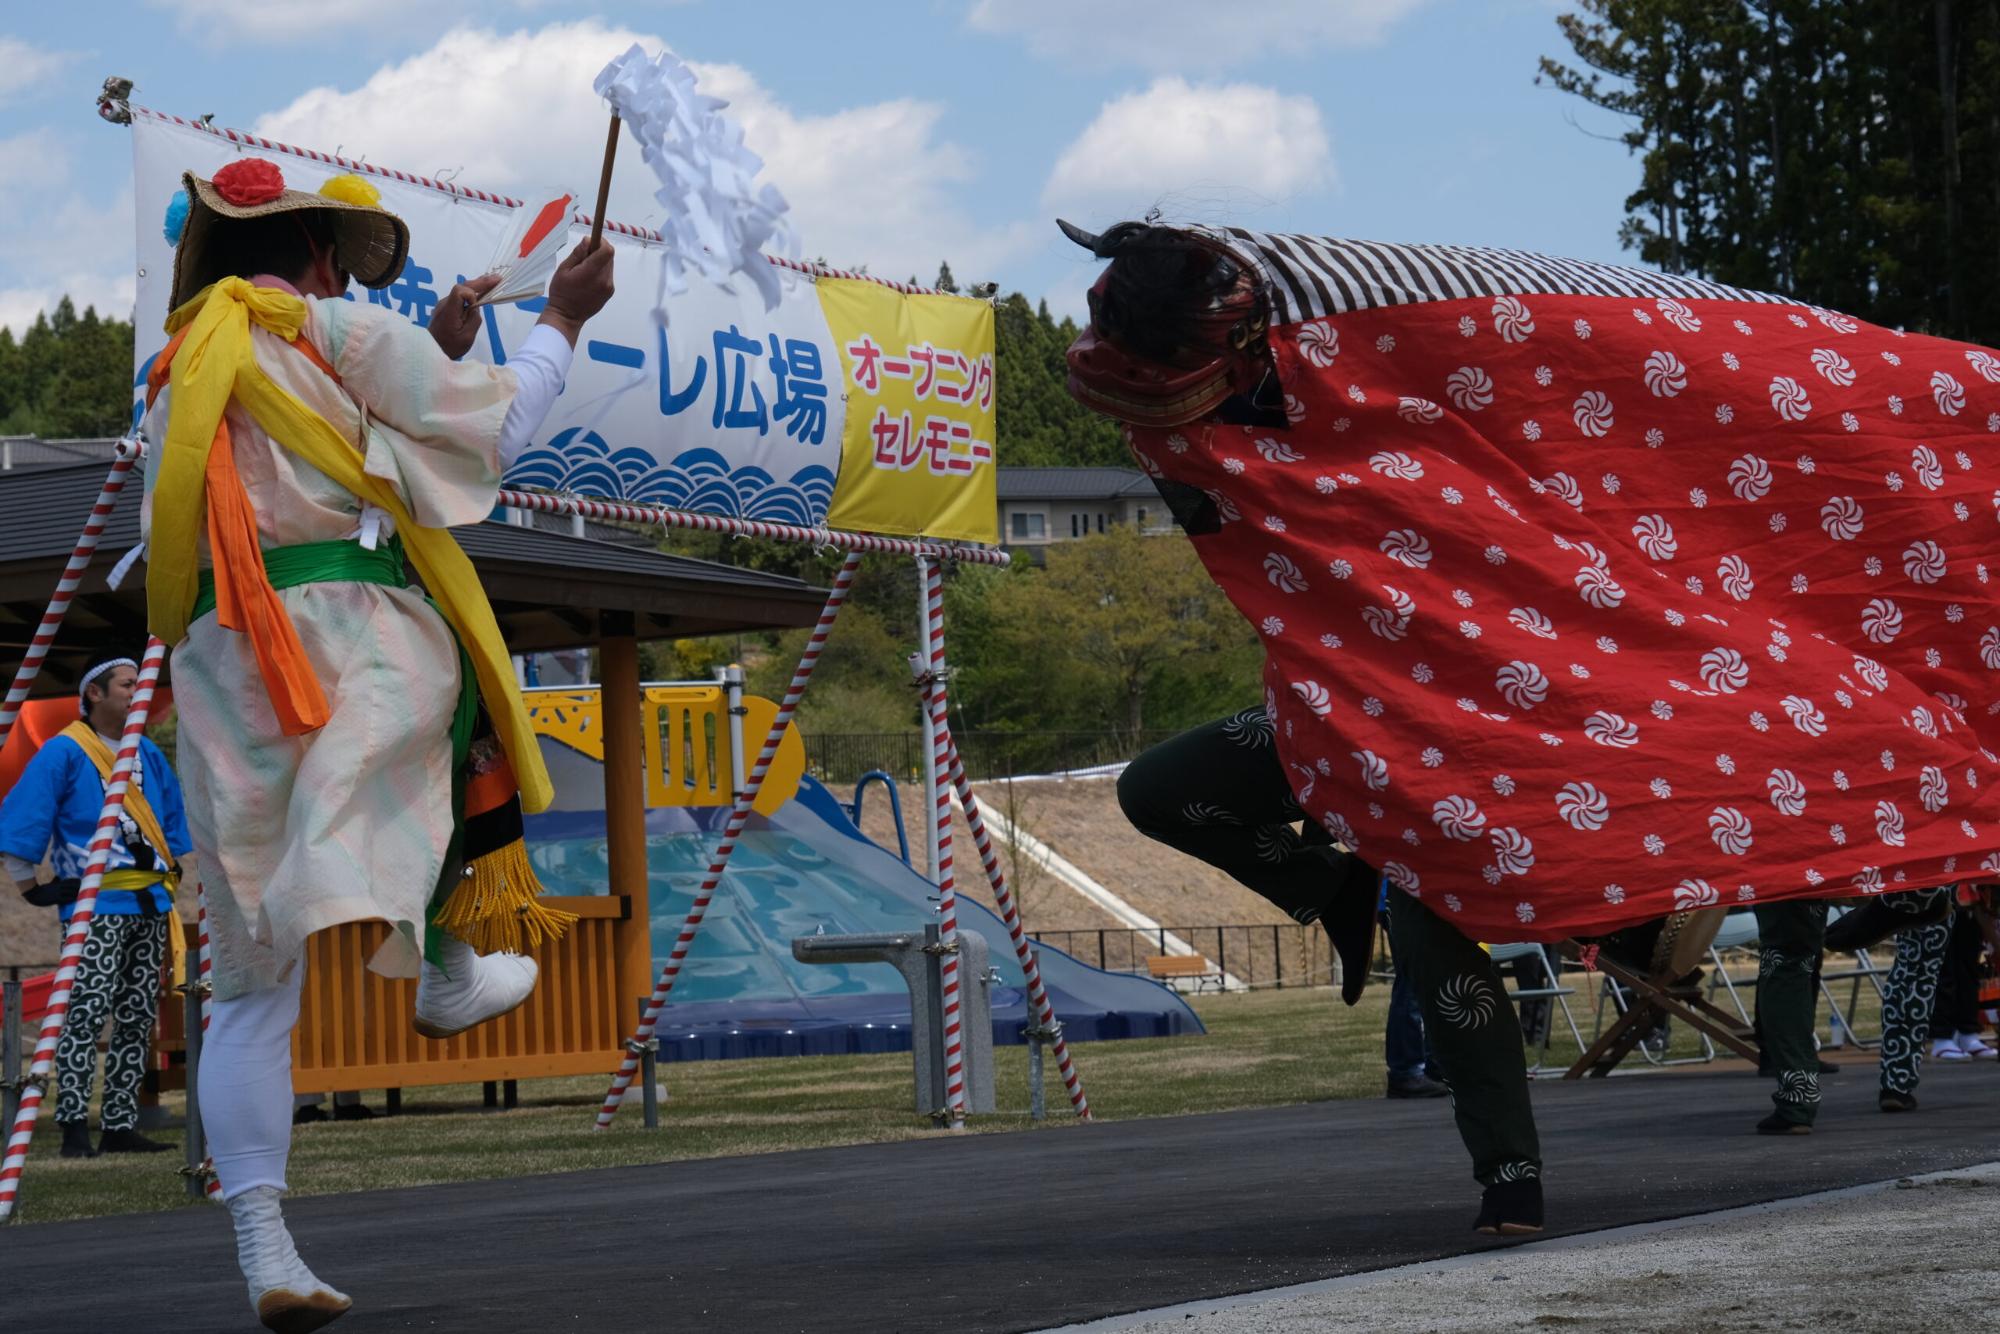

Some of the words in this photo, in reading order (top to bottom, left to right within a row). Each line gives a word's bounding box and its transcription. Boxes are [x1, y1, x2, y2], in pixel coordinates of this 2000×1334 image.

[849, 338, 993, 408] オープニング
[872, 411, 991, 471] セレモニー
